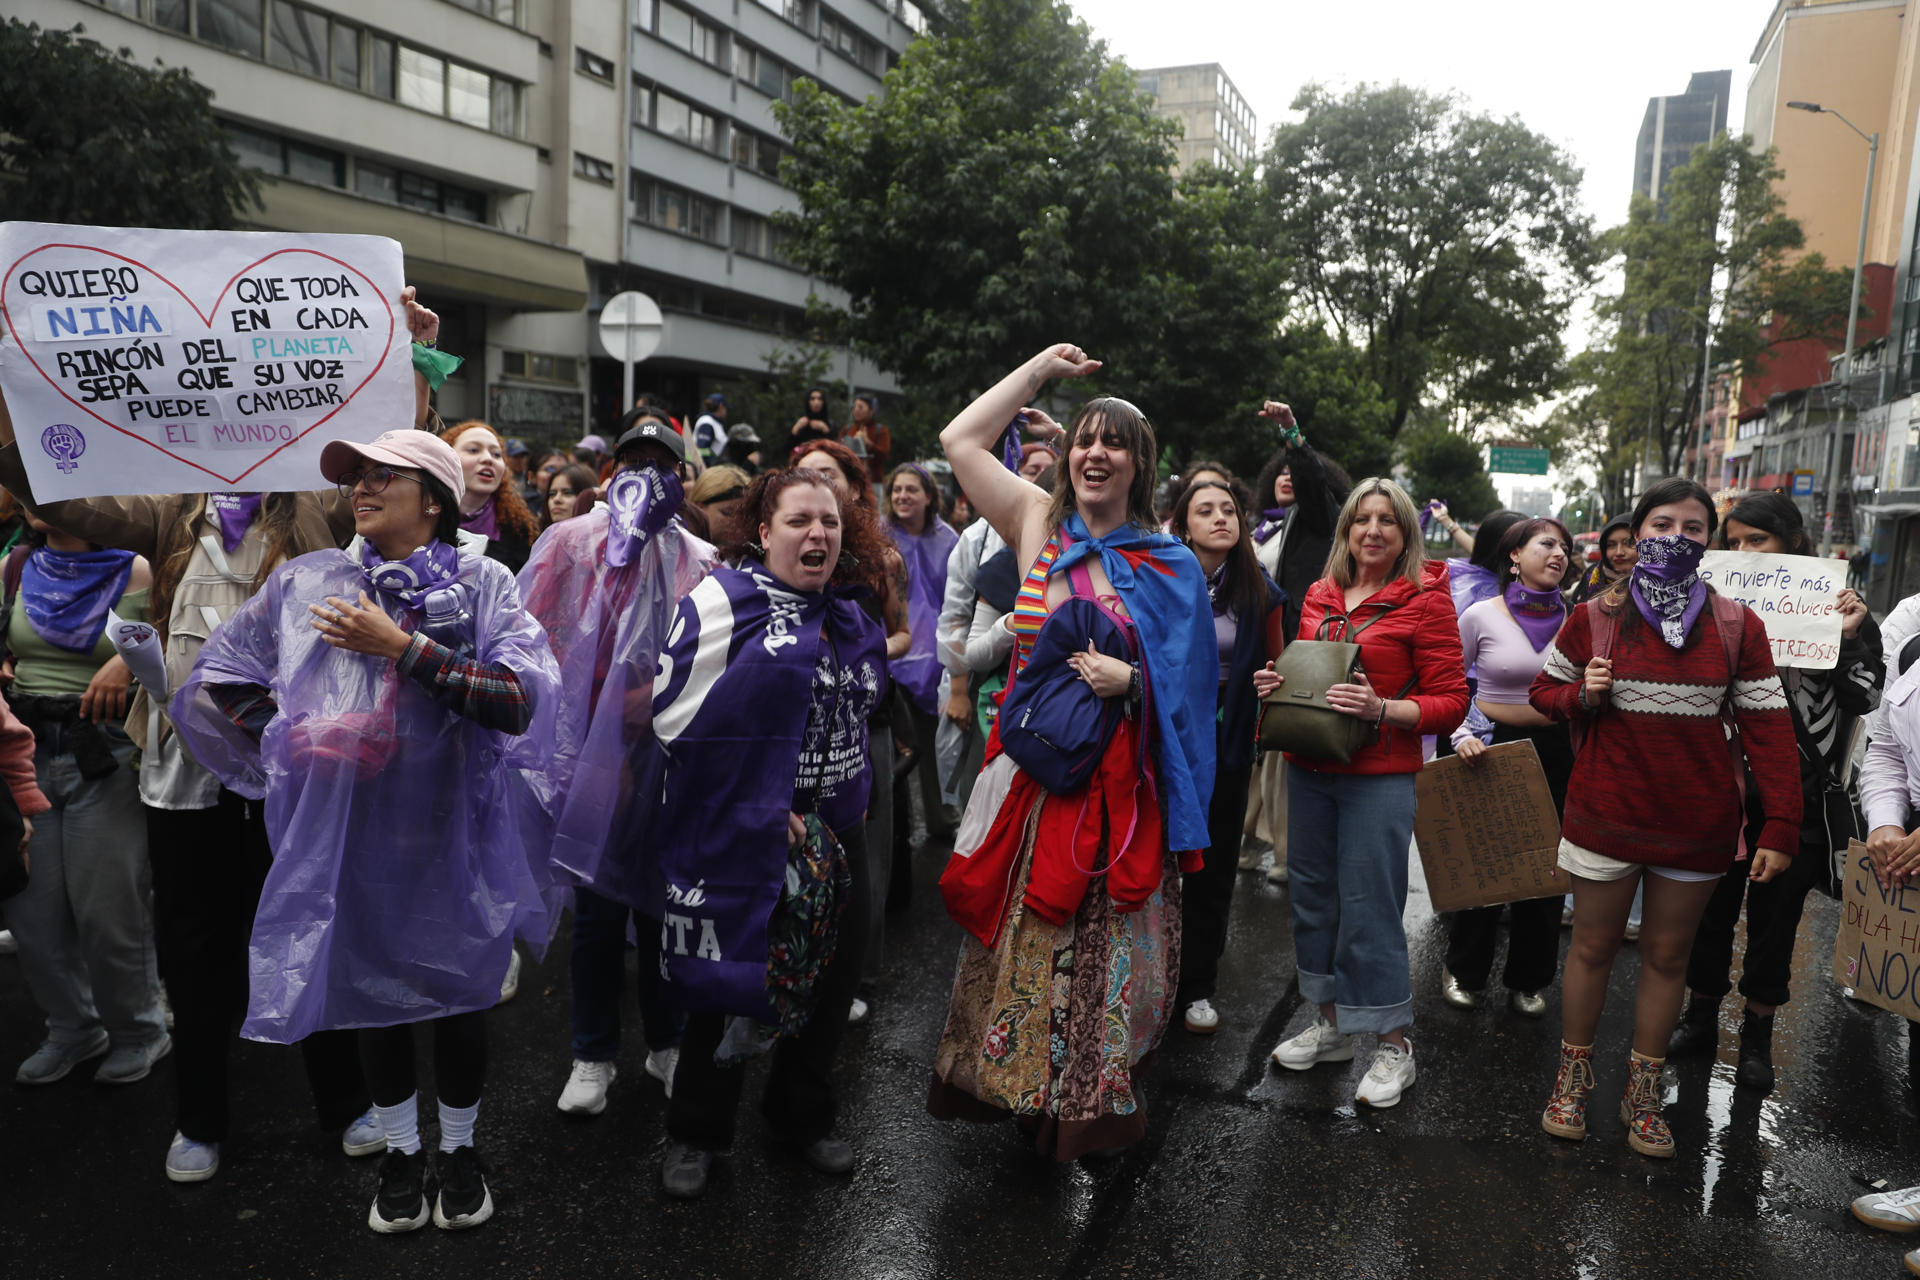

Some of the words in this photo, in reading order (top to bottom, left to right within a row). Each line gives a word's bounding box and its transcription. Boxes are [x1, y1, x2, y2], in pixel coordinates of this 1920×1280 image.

[19, 266, 139, 299] QUIERO
[236, 276, 289, 305] QUE
[290, 274, 359, 300] TODA
[46, 295, 163, 338] NIÑA
[231, 308, 271, 333] EN
[296, 306, 369, 331] CADA
[56, 338, 165, 378] RINCÓN
[182, 338, 237, 366] DEL
[251, 335, 355, 359] PLANETA
[77, 372, 150, 403] SEPA
[176, 366, 234, 391] QUE
[254, 362, 286, 387] SU
[296, 359, 344, 381] VOZ
[127, 399, 211, 422] PUEDE
[236, 382, 345, 416] CAMBIAR
[165, 424, 196, 444] EL
[213, 423, 293, 444] MUNDO
[1725, 565, 1791, 589] invierte
[1800, 575, 1831, 593] más
[1761, 596, 1776, 611] la
[1768, 638, 1838, 663] TRIOSIS
[794, 772, 838, 789] TERRIORIO
